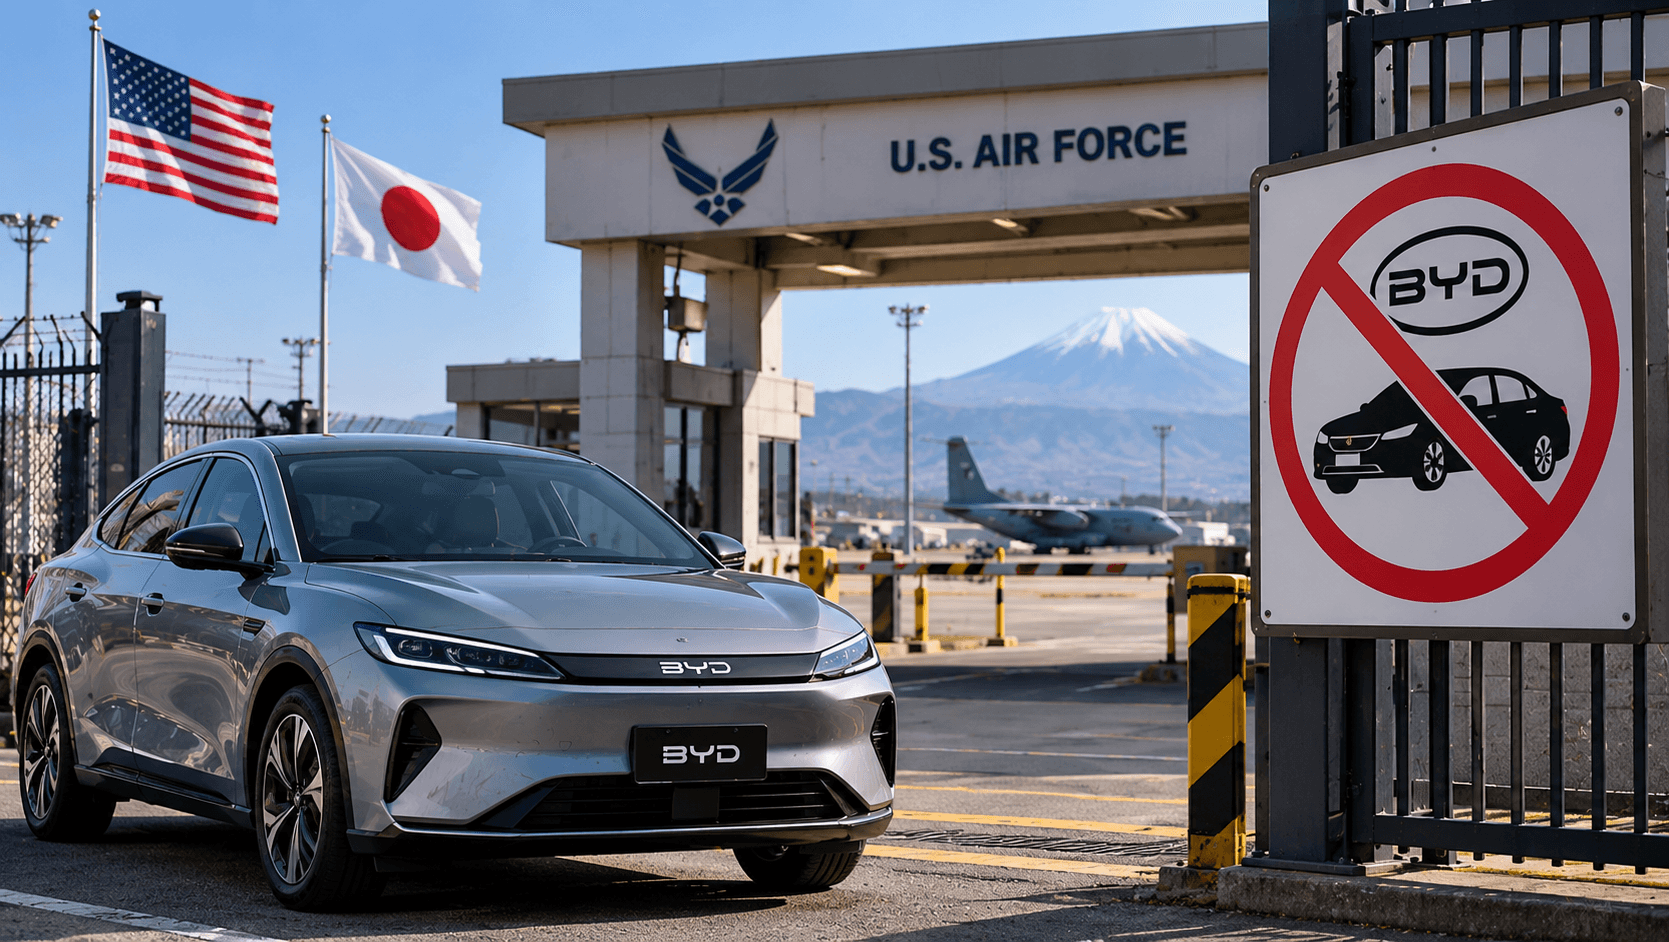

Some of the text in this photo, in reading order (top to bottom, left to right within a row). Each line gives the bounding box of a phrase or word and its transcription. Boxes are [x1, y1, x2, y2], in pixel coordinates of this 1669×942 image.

[891, 121, 1187, 173] U.S. AIR FORCE
[1389, 258, 1510, 306] BYD
[659, 662, 731, 674] BYD
[663, 745, 740, 764] BYD
